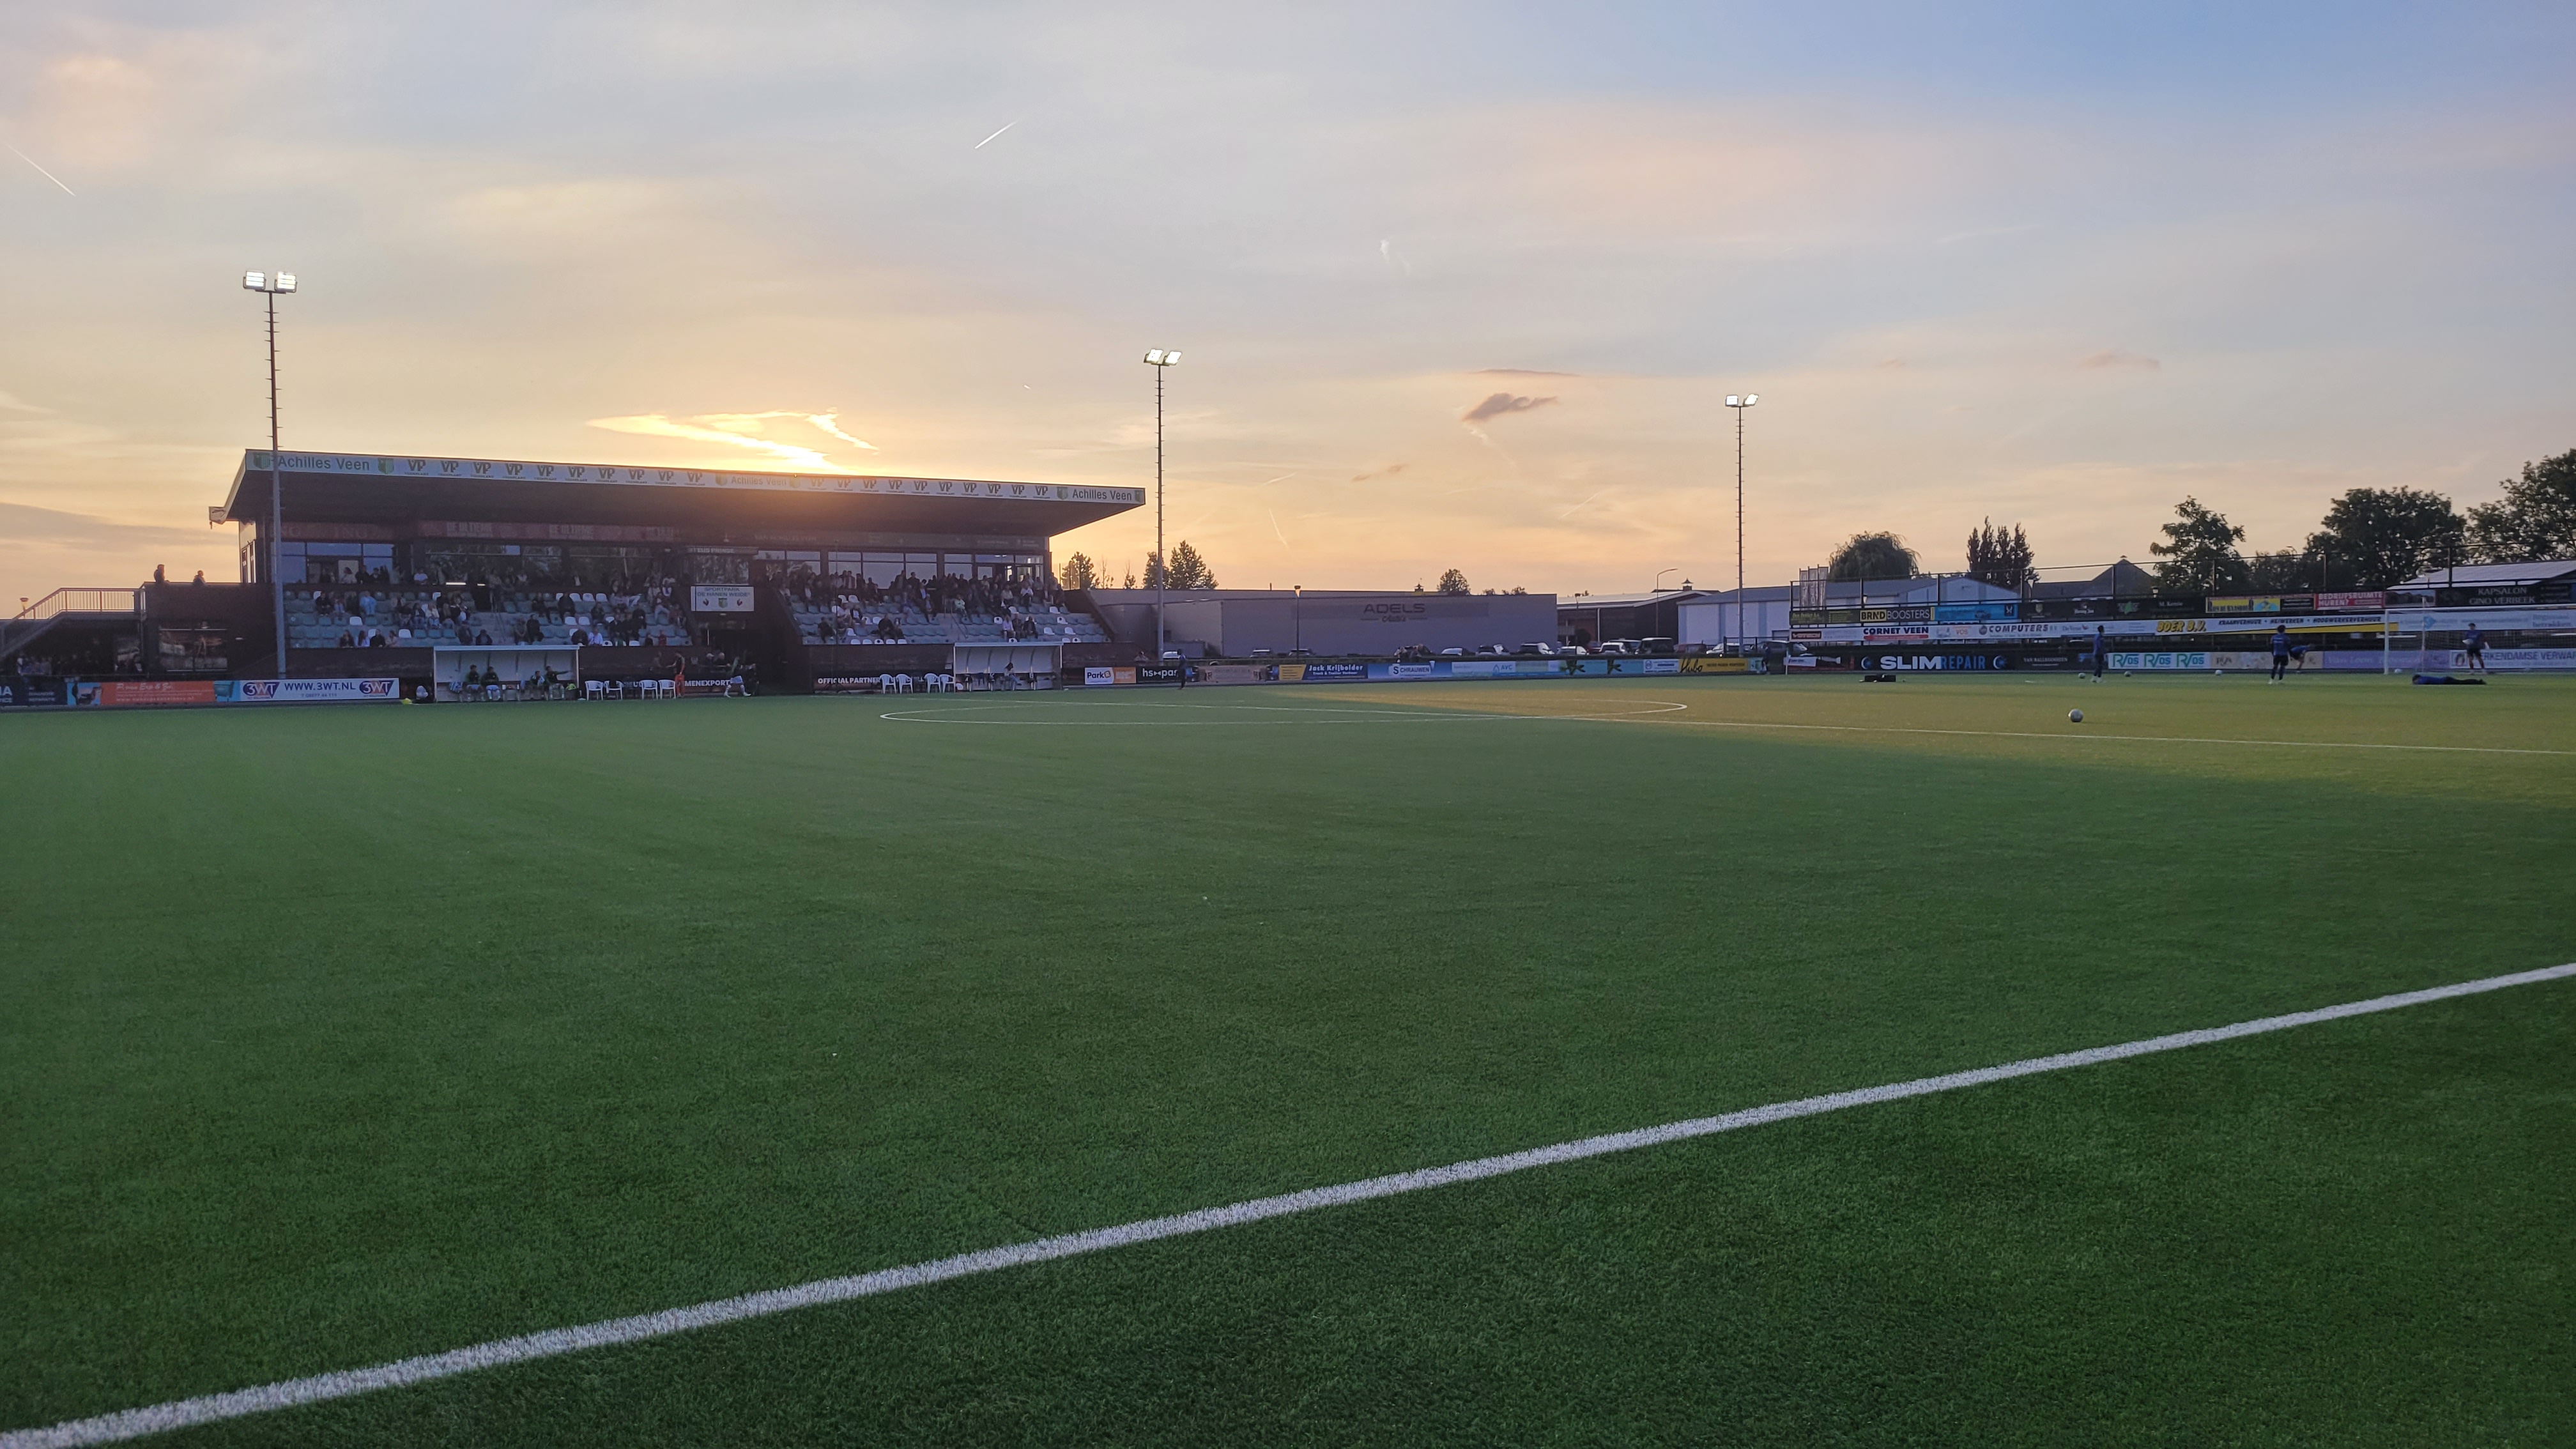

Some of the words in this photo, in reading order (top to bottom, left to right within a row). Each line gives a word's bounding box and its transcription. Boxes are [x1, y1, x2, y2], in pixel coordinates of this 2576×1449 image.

[277, 456, 331, 469] Achilles
[335, 458, 369, 471] Veen
[408, 459, 426, 471] VP
[441, 461, 459, 472] VP
[473, 462, 491, 473] VP
[505, 463, 523, 475] VP
[537, 464, 555, 477] VP
[568, 466, 585, 478] VP
[599, 468, 615, 479] VP
[628, 469, 645, 480] VP
[658, 470, 674, 481] VP
[687, 471, 703, 482] VP
[731, 476, 763, 486] Achilles
[766, 478, 786, 486] Veen
[837, 479, 851, 488] VP
[863, 479, 877, 489] VP
[889, 480, 902, 489] VP
[914, 480, 928, 491] VP
[939, 482, 953, 491] VP
[963, 482, 977, 493] VP
[988, 484, 1001, 493] VP
[1012, 484, 1025, 494] VP
[1036, 486, 1048, 496] VP
[1072, 489, 1107, 499] Achilles
[1110, 490, 1132, 500] Veen
[2478, 586, 2527, 595] KAPSALON
[2494, 595, 2536, 604] VERBEEK
[1363, 603, 1425, 614] ADELS
[1887, 609, 1930, 619] BOOSTERS
[2156, 620, 2185, 632] BOER
[2187, 620, 2207, 632] B.V.
[2480, 652, 2538, 660] ERKENDAMSE
[1393, 666, 1430, 675] SCHRAUWEN
[247, 682, 277, 695] 3WT
[284, 682, 356, 691] WWW.3WT.NL
[363, 682, 391, 694] 3WT
